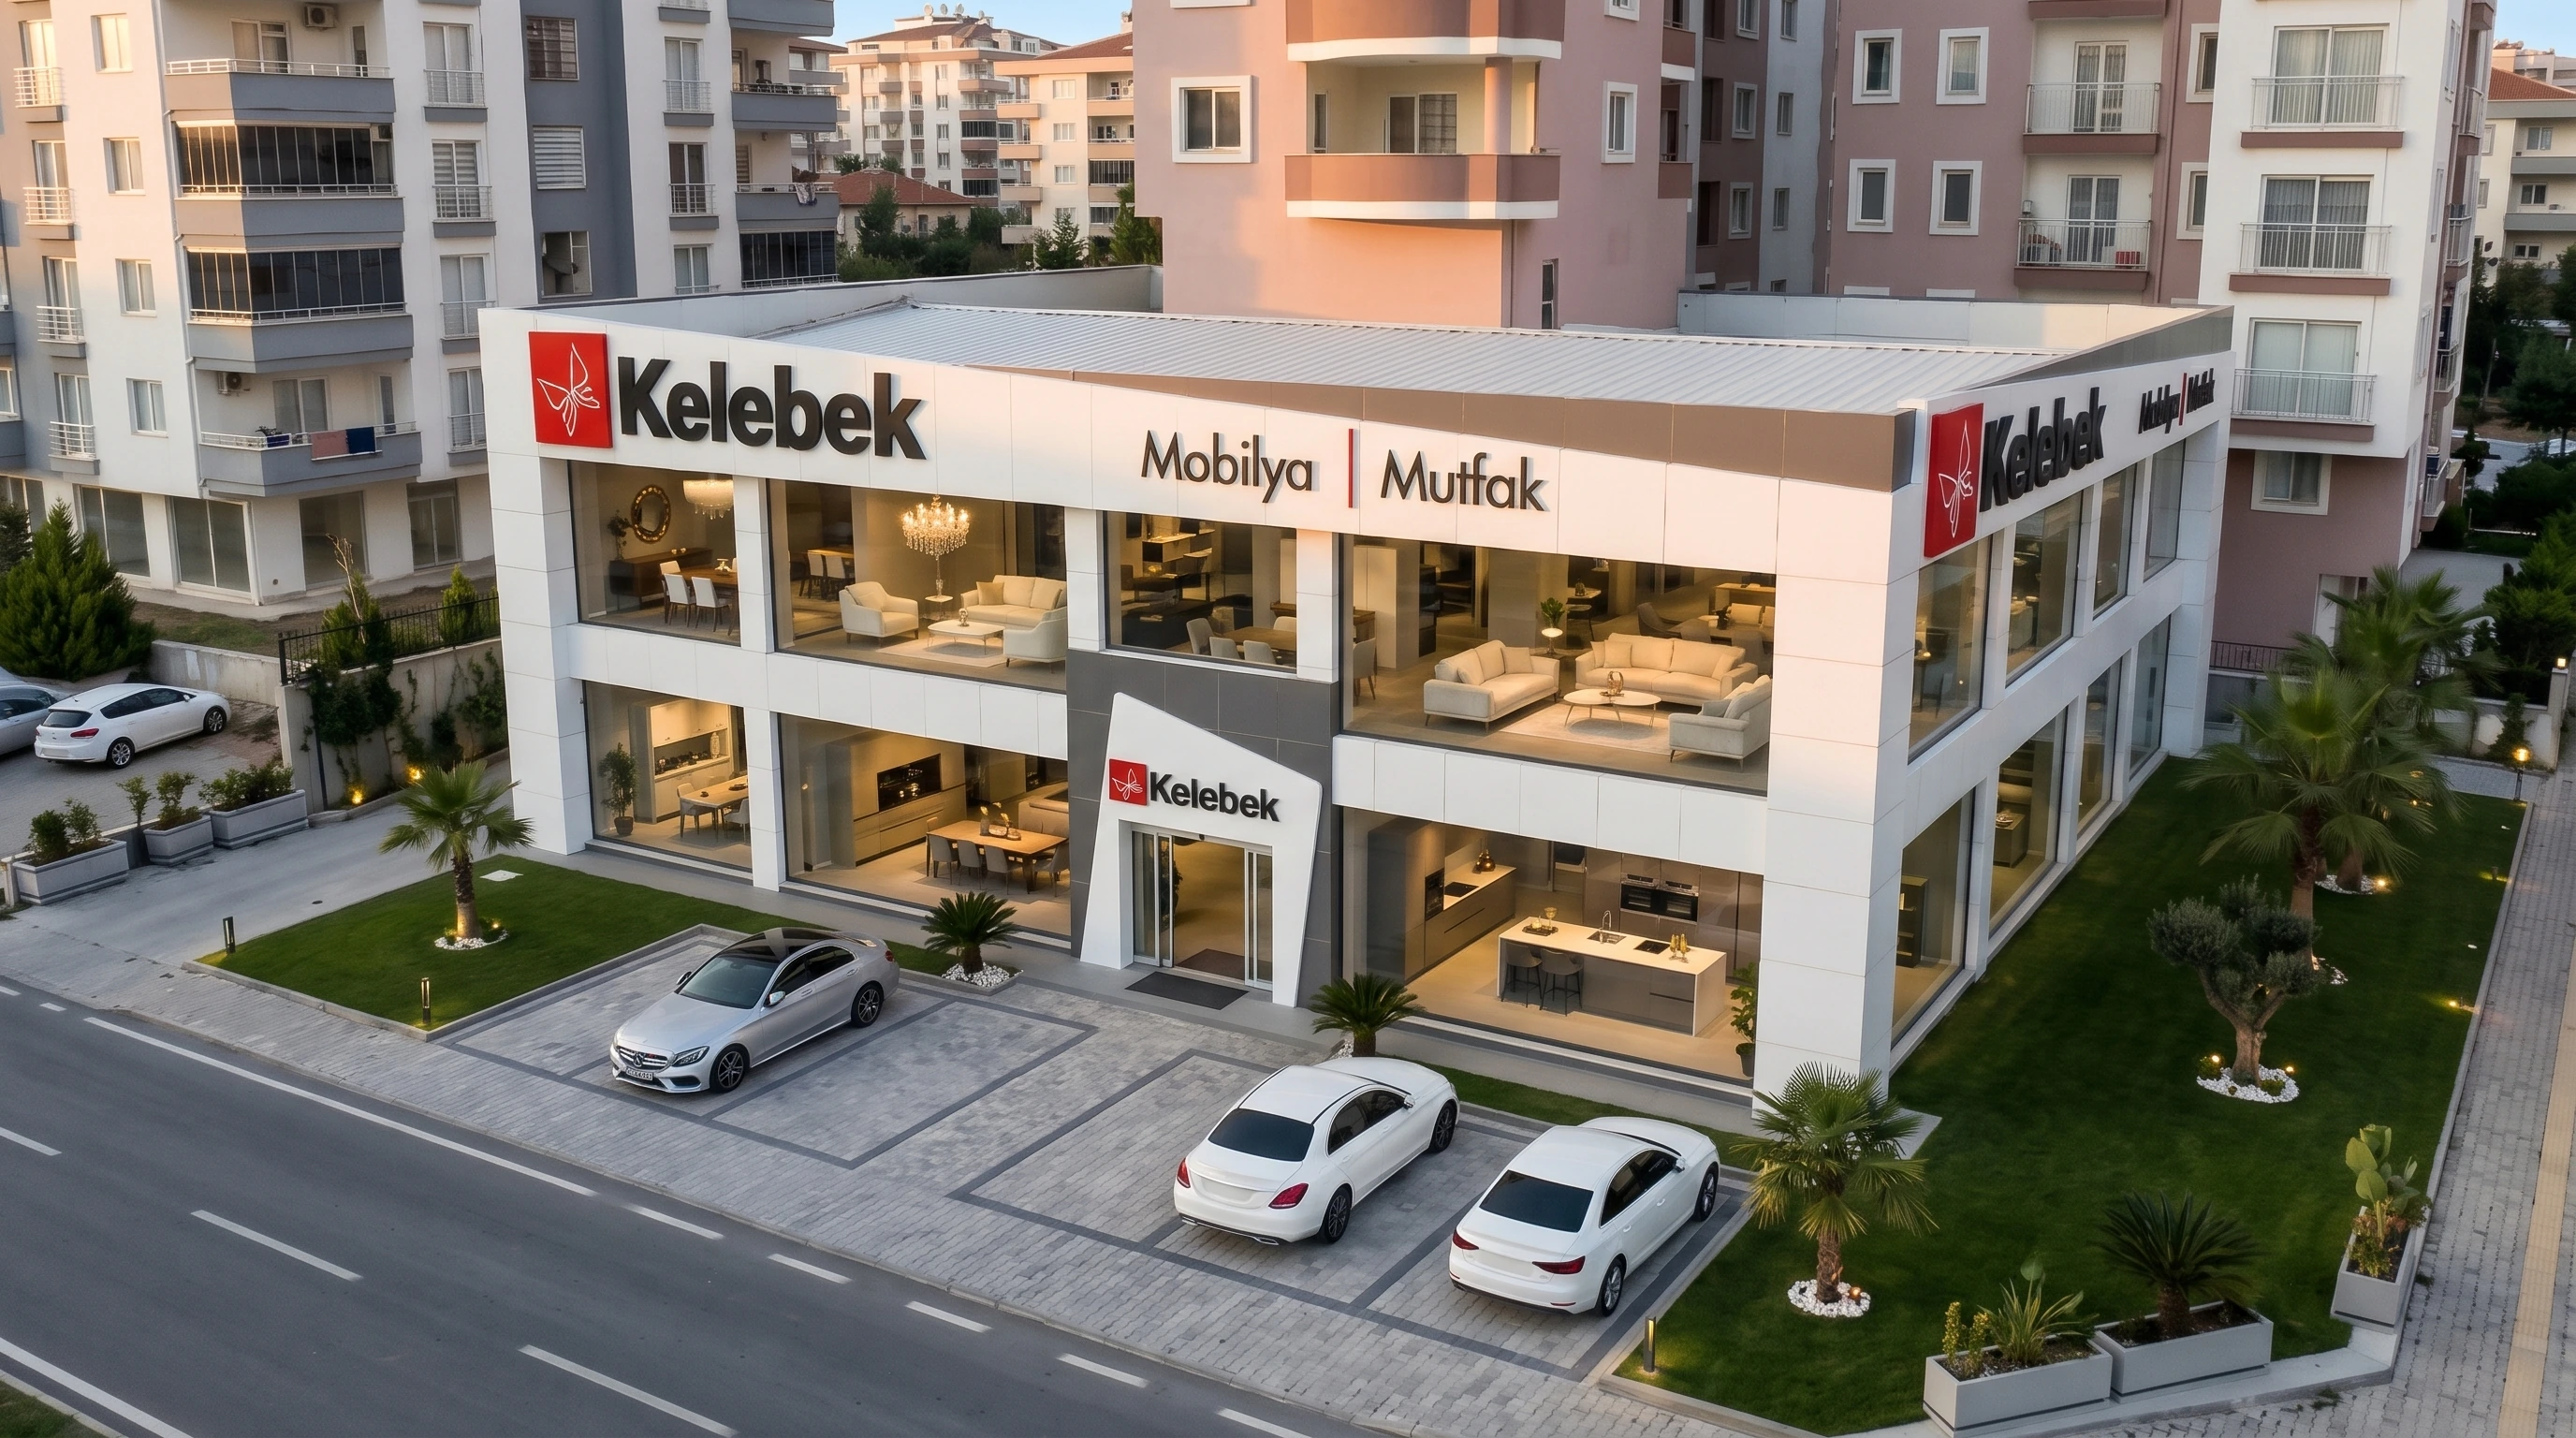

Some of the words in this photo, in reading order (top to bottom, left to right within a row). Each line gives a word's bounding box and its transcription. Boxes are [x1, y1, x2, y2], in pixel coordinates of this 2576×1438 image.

[617, 356, 928, 460] Kelebek
[1979, 387, 2107, 512] Kelebek
[1141, 430, 1313, 504] Mobilya
[1381, 449, 1547, 512] Mutfak
[1149, 771, 1280, 822] Kelebek
